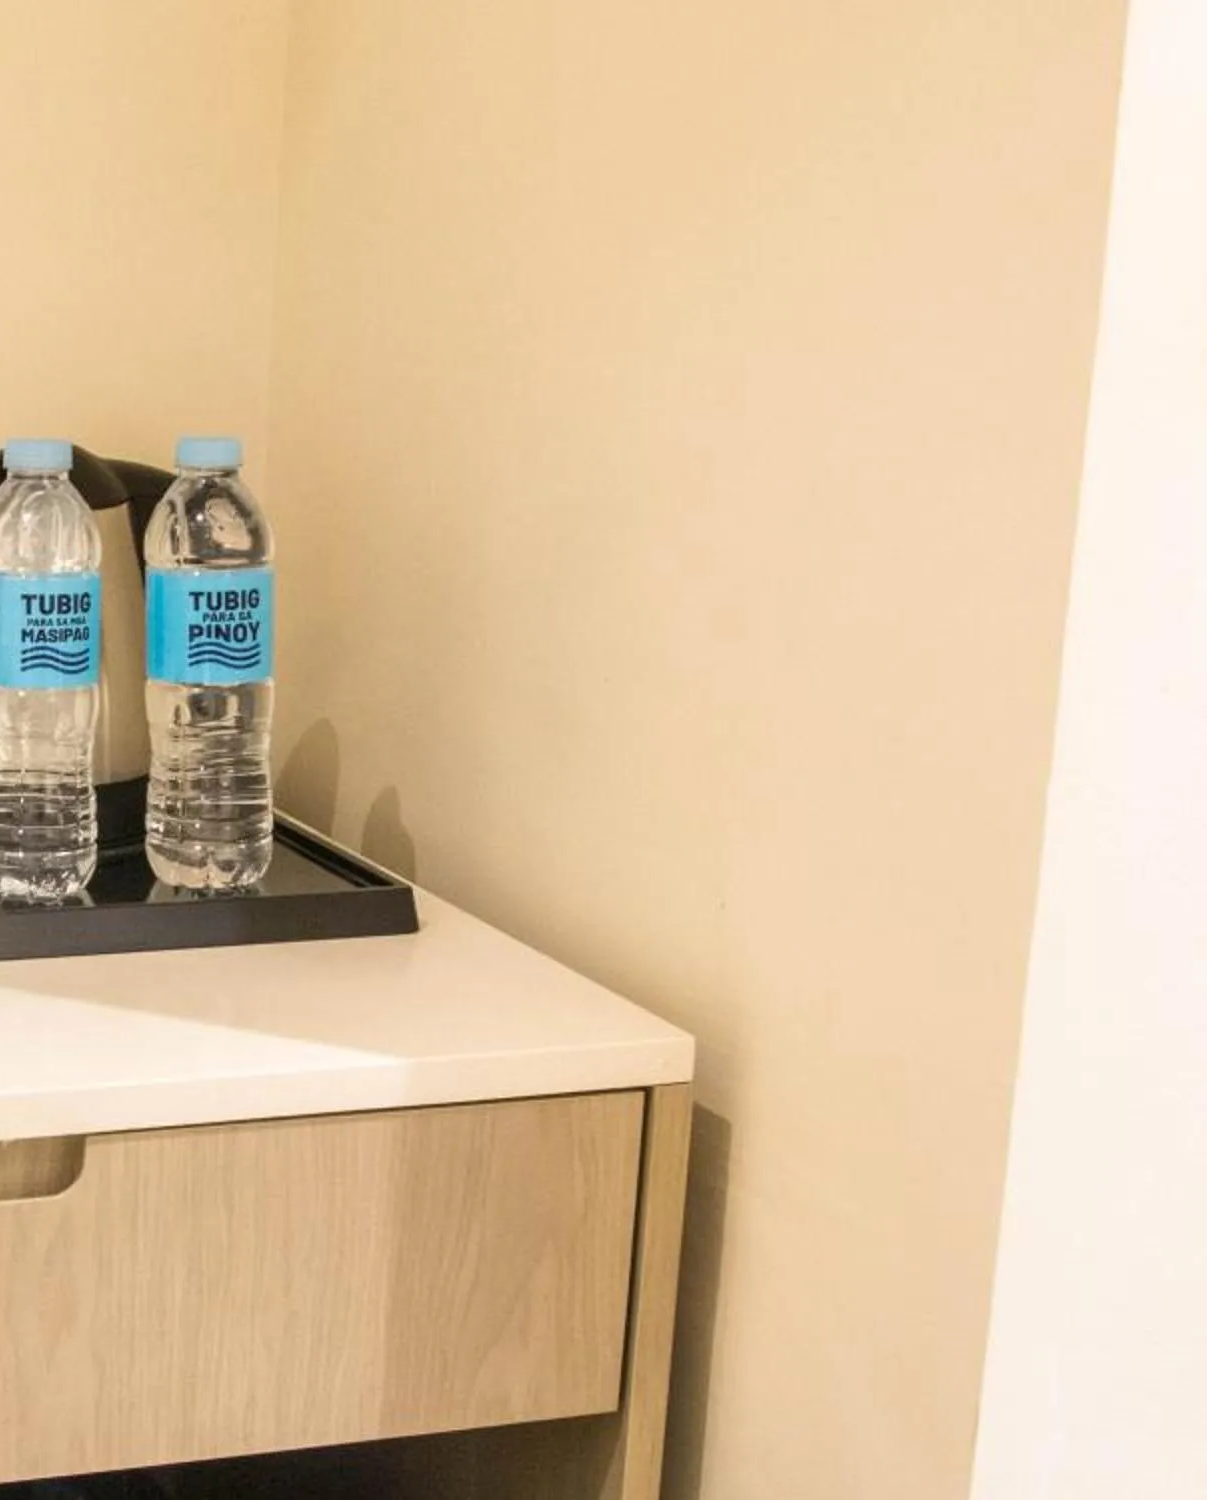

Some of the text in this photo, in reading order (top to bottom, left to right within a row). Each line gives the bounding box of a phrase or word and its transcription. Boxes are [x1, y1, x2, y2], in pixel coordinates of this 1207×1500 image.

[21, 592, 91, 615] TUBIG
[189, 588, 260, 611] TUBIG
[27, 617, 54, 627] PARA
[202, 612, 235, 622] PARA
[21, 626, 90, 643] MASIPAG
[189, 621, 260, 643] PINOY
